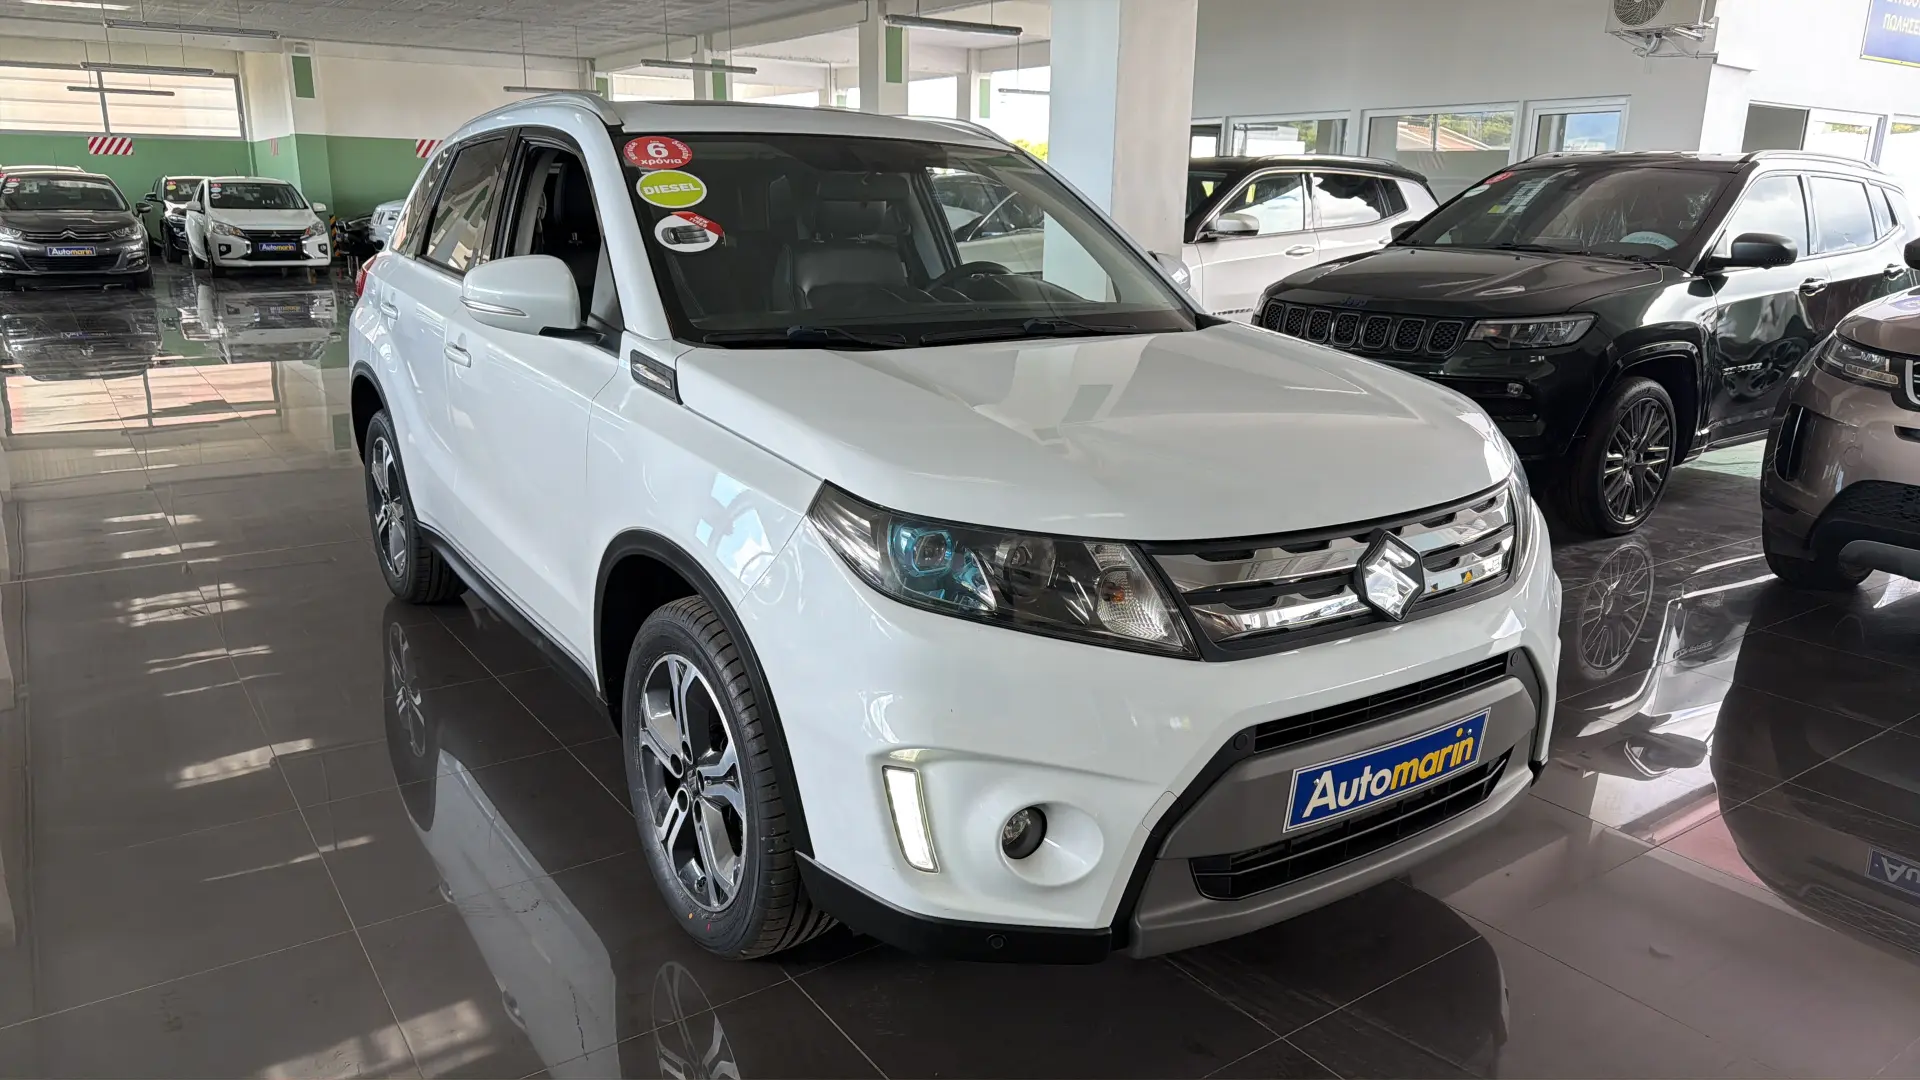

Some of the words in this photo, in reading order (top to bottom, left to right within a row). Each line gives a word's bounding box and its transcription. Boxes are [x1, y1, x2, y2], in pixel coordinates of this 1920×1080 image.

[646, 142, 669, 158] 6
[640, 157, 682, 166] χρόνια
[643, 183, 701, 195] DIESEL
[51, 247, 93, 255] Automarin
[1302, 727, 1475, 818] Automarin
